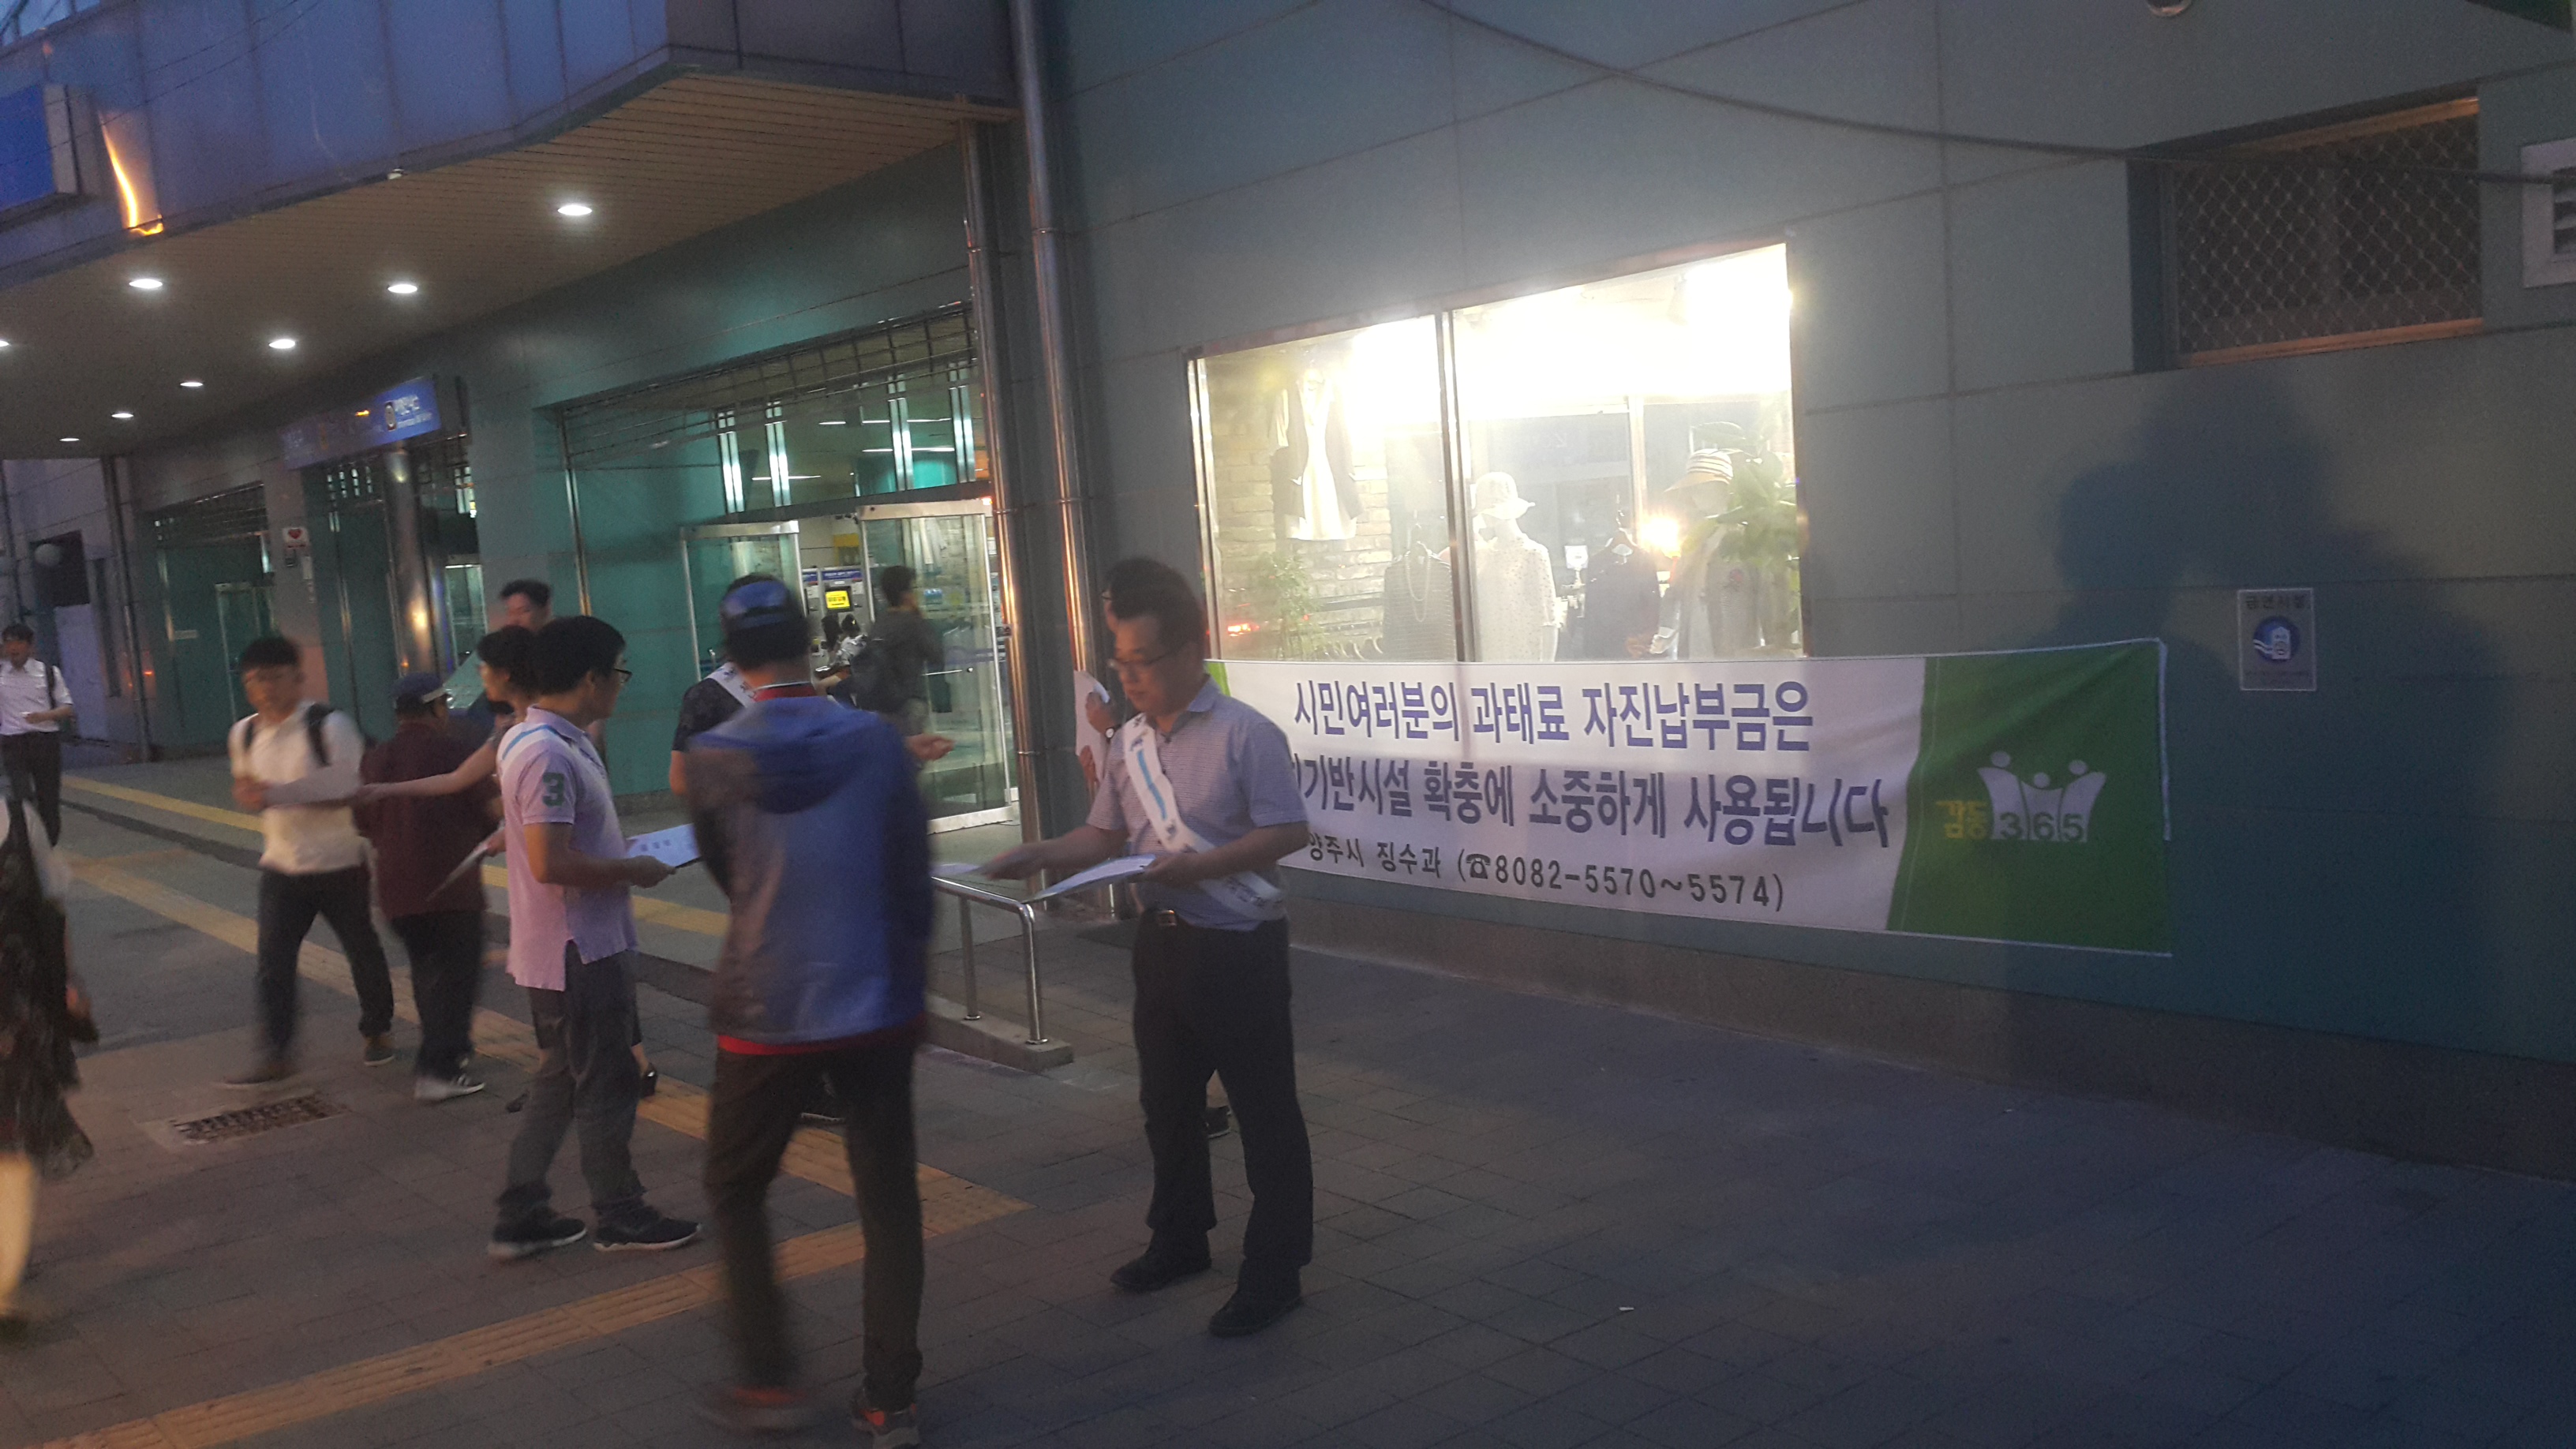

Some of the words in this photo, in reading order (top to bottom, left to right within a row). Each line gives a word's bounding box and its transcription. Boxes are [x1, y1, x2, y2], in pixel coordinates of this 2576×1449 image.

[1294, 680, 1459, 742] 시민여러분의
[1470, 682, 1570, 744] 과태료
[1582, 681, 1814, 751] 자진납부금은
[542, 772, 564, 807] 3
[1423, 760, 1515, 826] 확충에
[1528, 768, 1666, 839] 소중하게
[1683, 774, 1889, 848] 사용됩니다
[1376, 841, 1441, 878] 징수과
